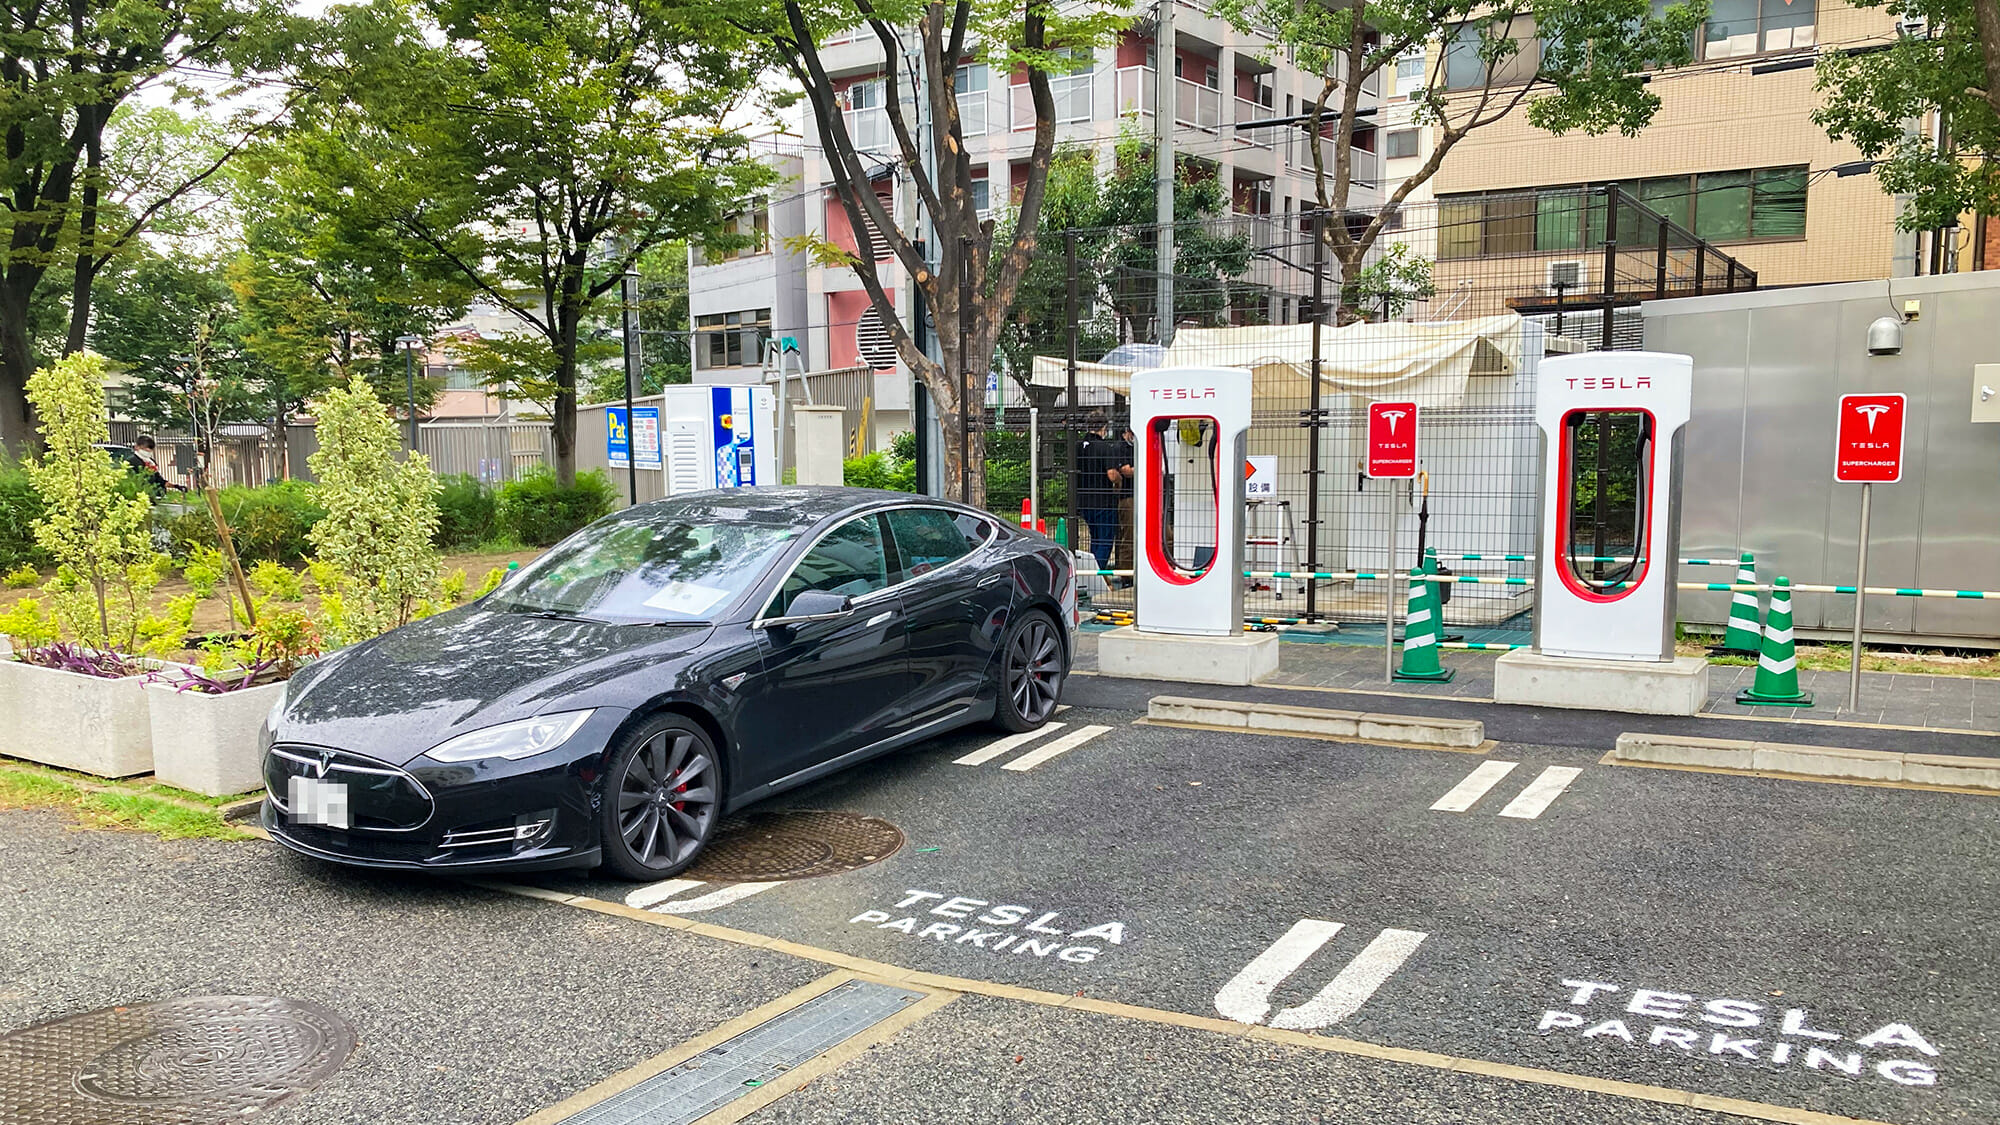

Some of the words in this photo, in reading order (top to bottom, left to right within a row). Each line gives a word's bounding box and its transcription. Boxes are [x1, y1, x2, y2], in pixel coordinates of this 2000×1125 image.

[1149, 388, 1215, 400] TESLA
[1565, 377, 1651, 390] TESLA
[608, 412, 626, 439] Pat
[849, 910, 1102, 963] PARKING
[896, 890, 1126, 945] TESLA
[1562, 979, 1941, 1057] TESLA
[1538, 1010, 1937, 1086] PARKING
